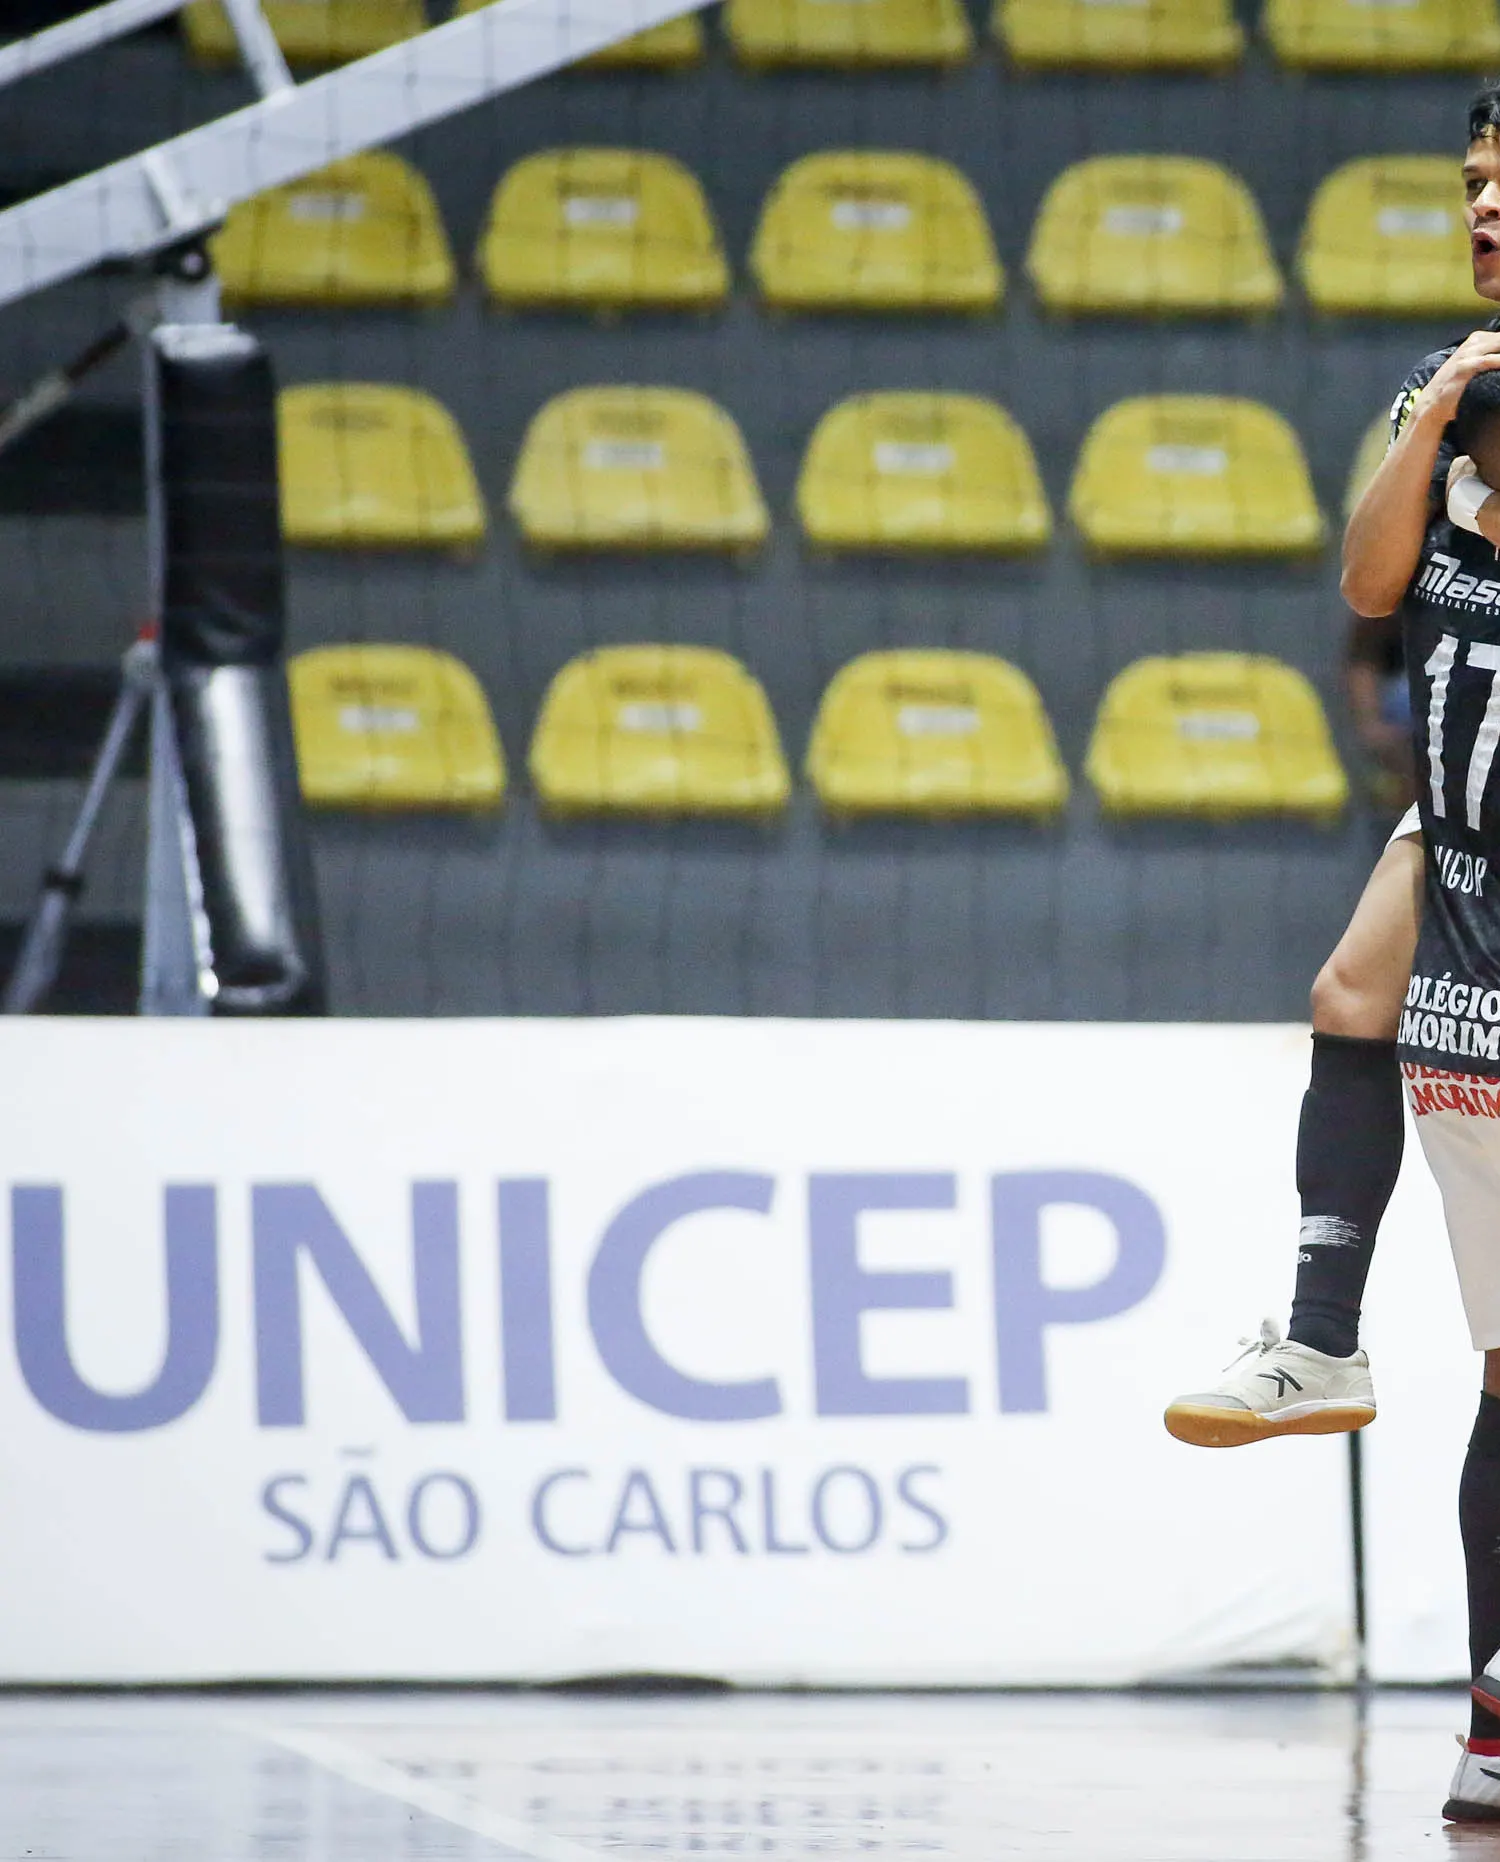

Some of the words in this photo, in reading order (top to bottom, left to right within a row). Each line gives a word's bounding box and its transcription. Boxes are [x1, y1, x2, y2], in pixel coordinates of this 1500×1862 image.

[10, 1167, 1169, 1436] UNICEP
[260, 1445, 484, 1566] SÃO
[530, 1463, 951, 1560] CARLOS
